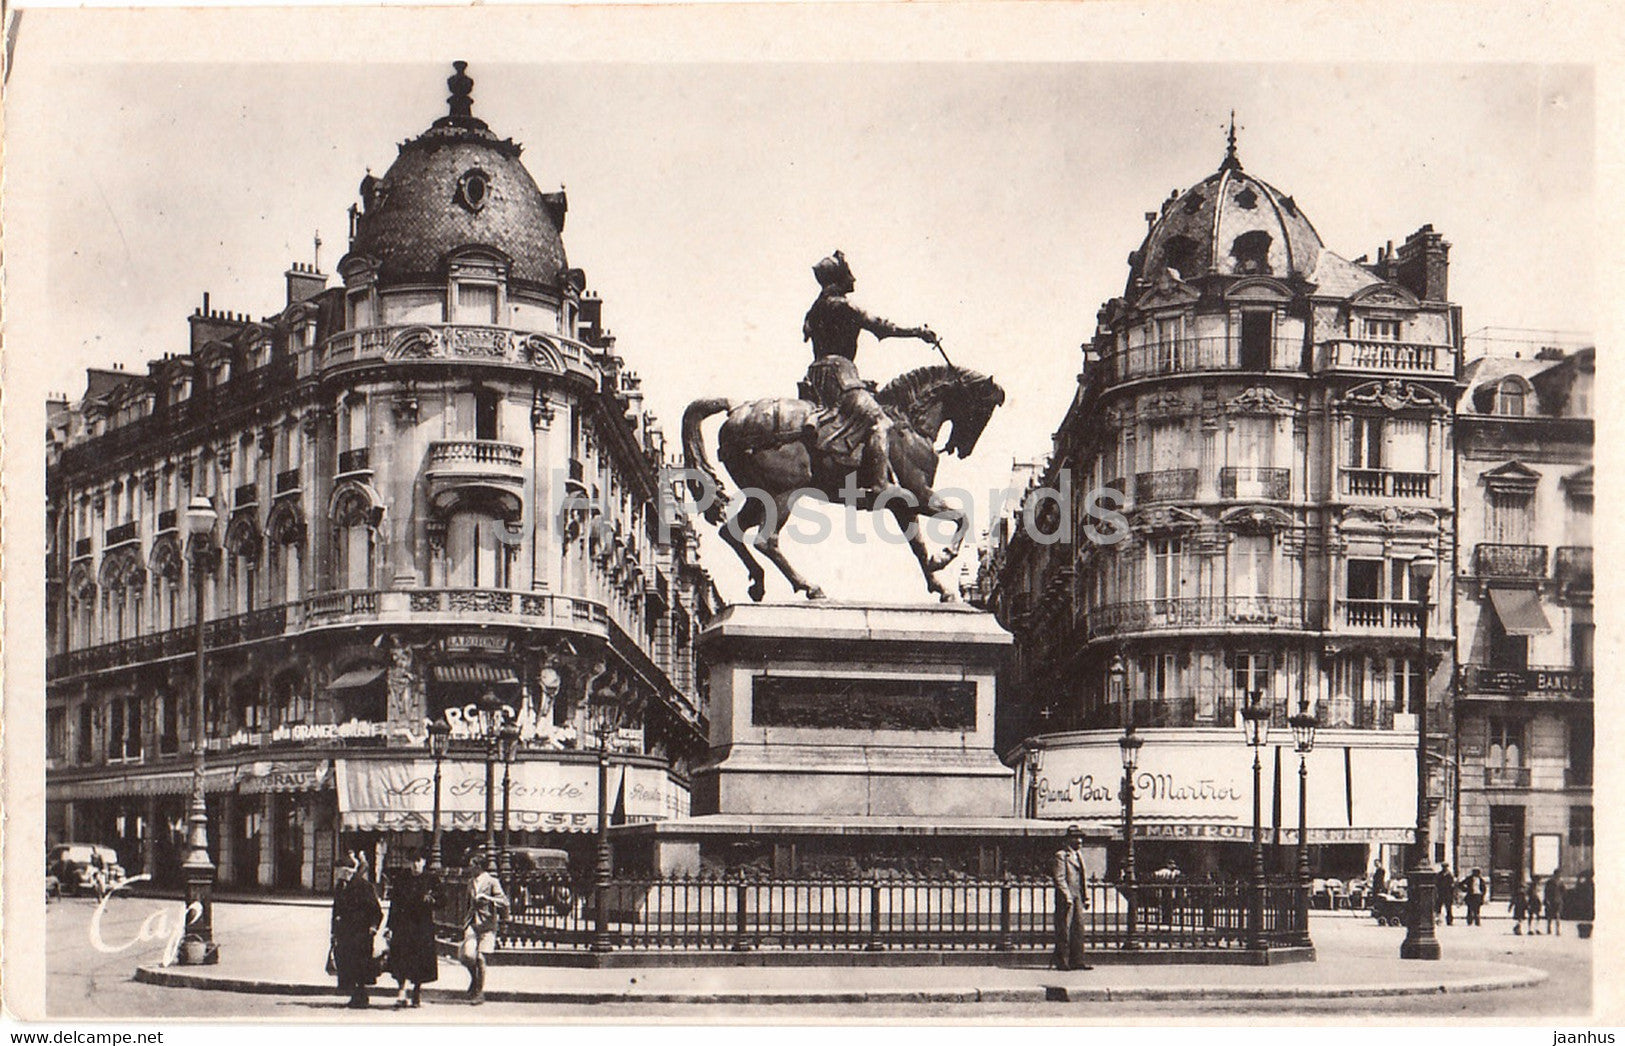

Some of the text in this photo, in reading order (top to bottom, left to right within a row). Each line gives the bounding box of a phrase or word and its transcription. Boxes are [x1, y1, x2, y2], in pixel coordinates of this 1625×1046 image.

[1537, 673, 1585, 691] BANQUE
[387, 777, 432, 797] La
[1072, 774, 1112, 802] Bar
[1138, 772, 1242, 802] Martroi
[377, 811, 430, 825] LA
[1146, 825, 1244, 837] MARTROI
